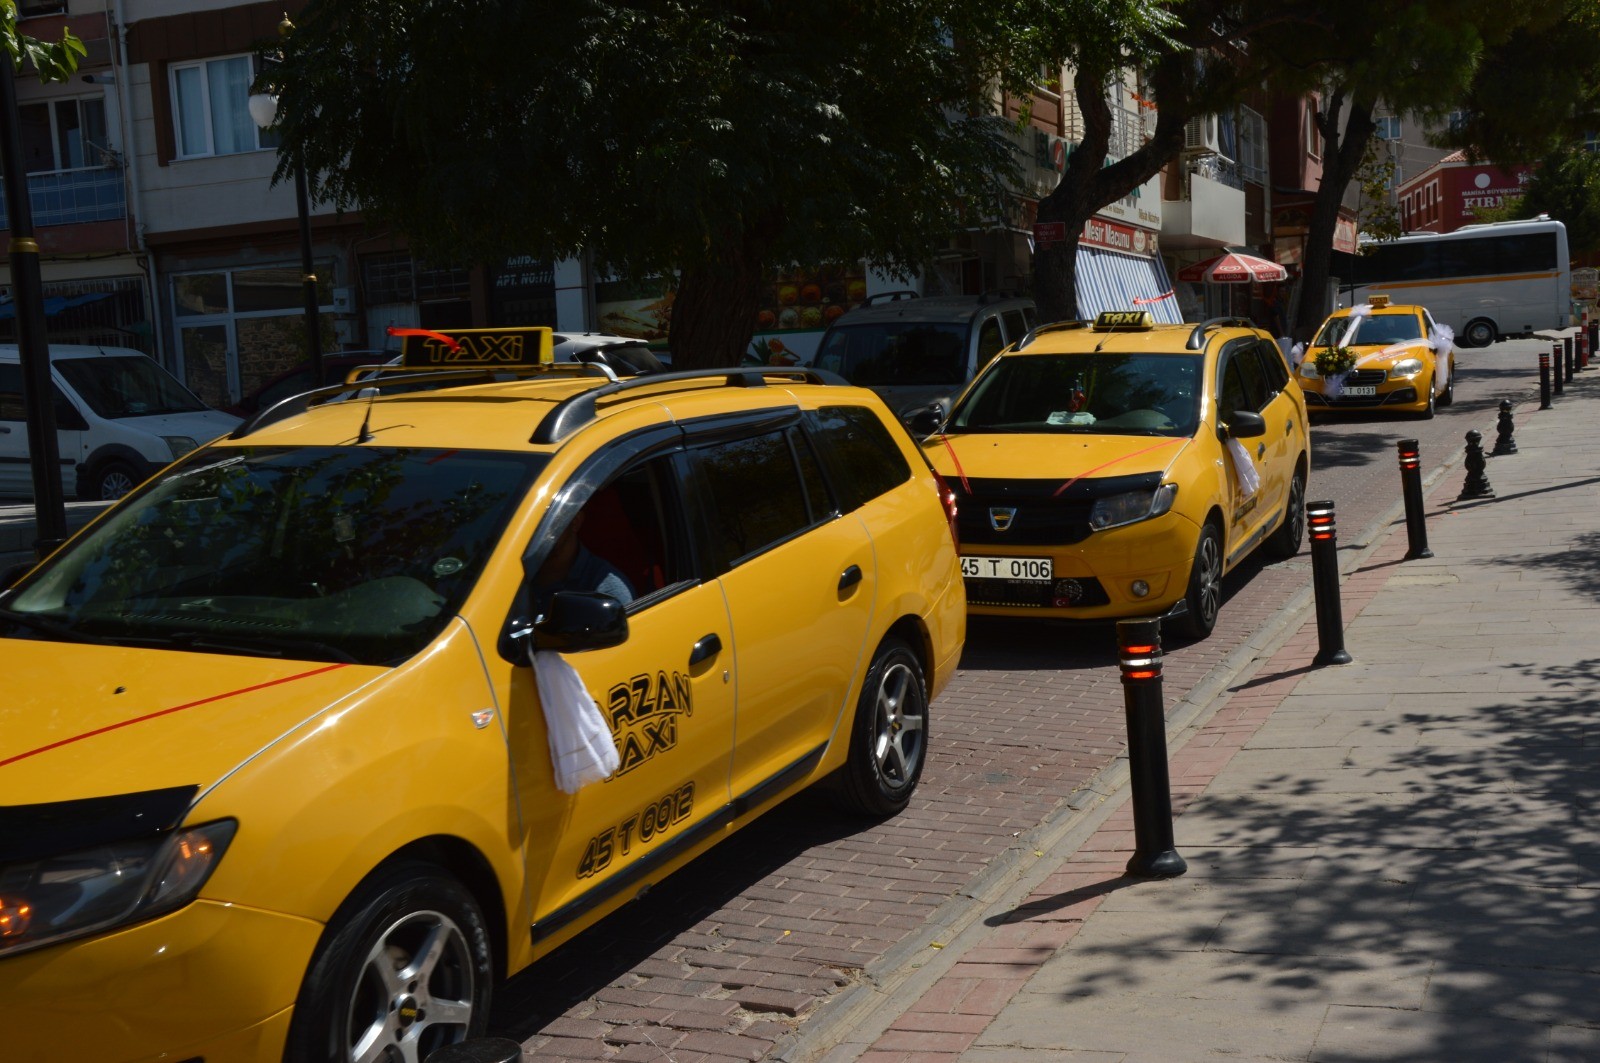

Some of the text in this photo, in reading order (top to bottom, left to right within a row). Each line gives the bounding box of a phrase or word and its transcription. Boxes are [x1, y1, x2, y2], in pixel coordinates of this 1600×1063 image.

[1085, 219, 1130, 249] Mesir Macunu
[1357, 387, 1375, 395] 0131
[960, 558, 1050, 578] 45 T 0106
[577, 781, 694, 879] 45 T 0012
